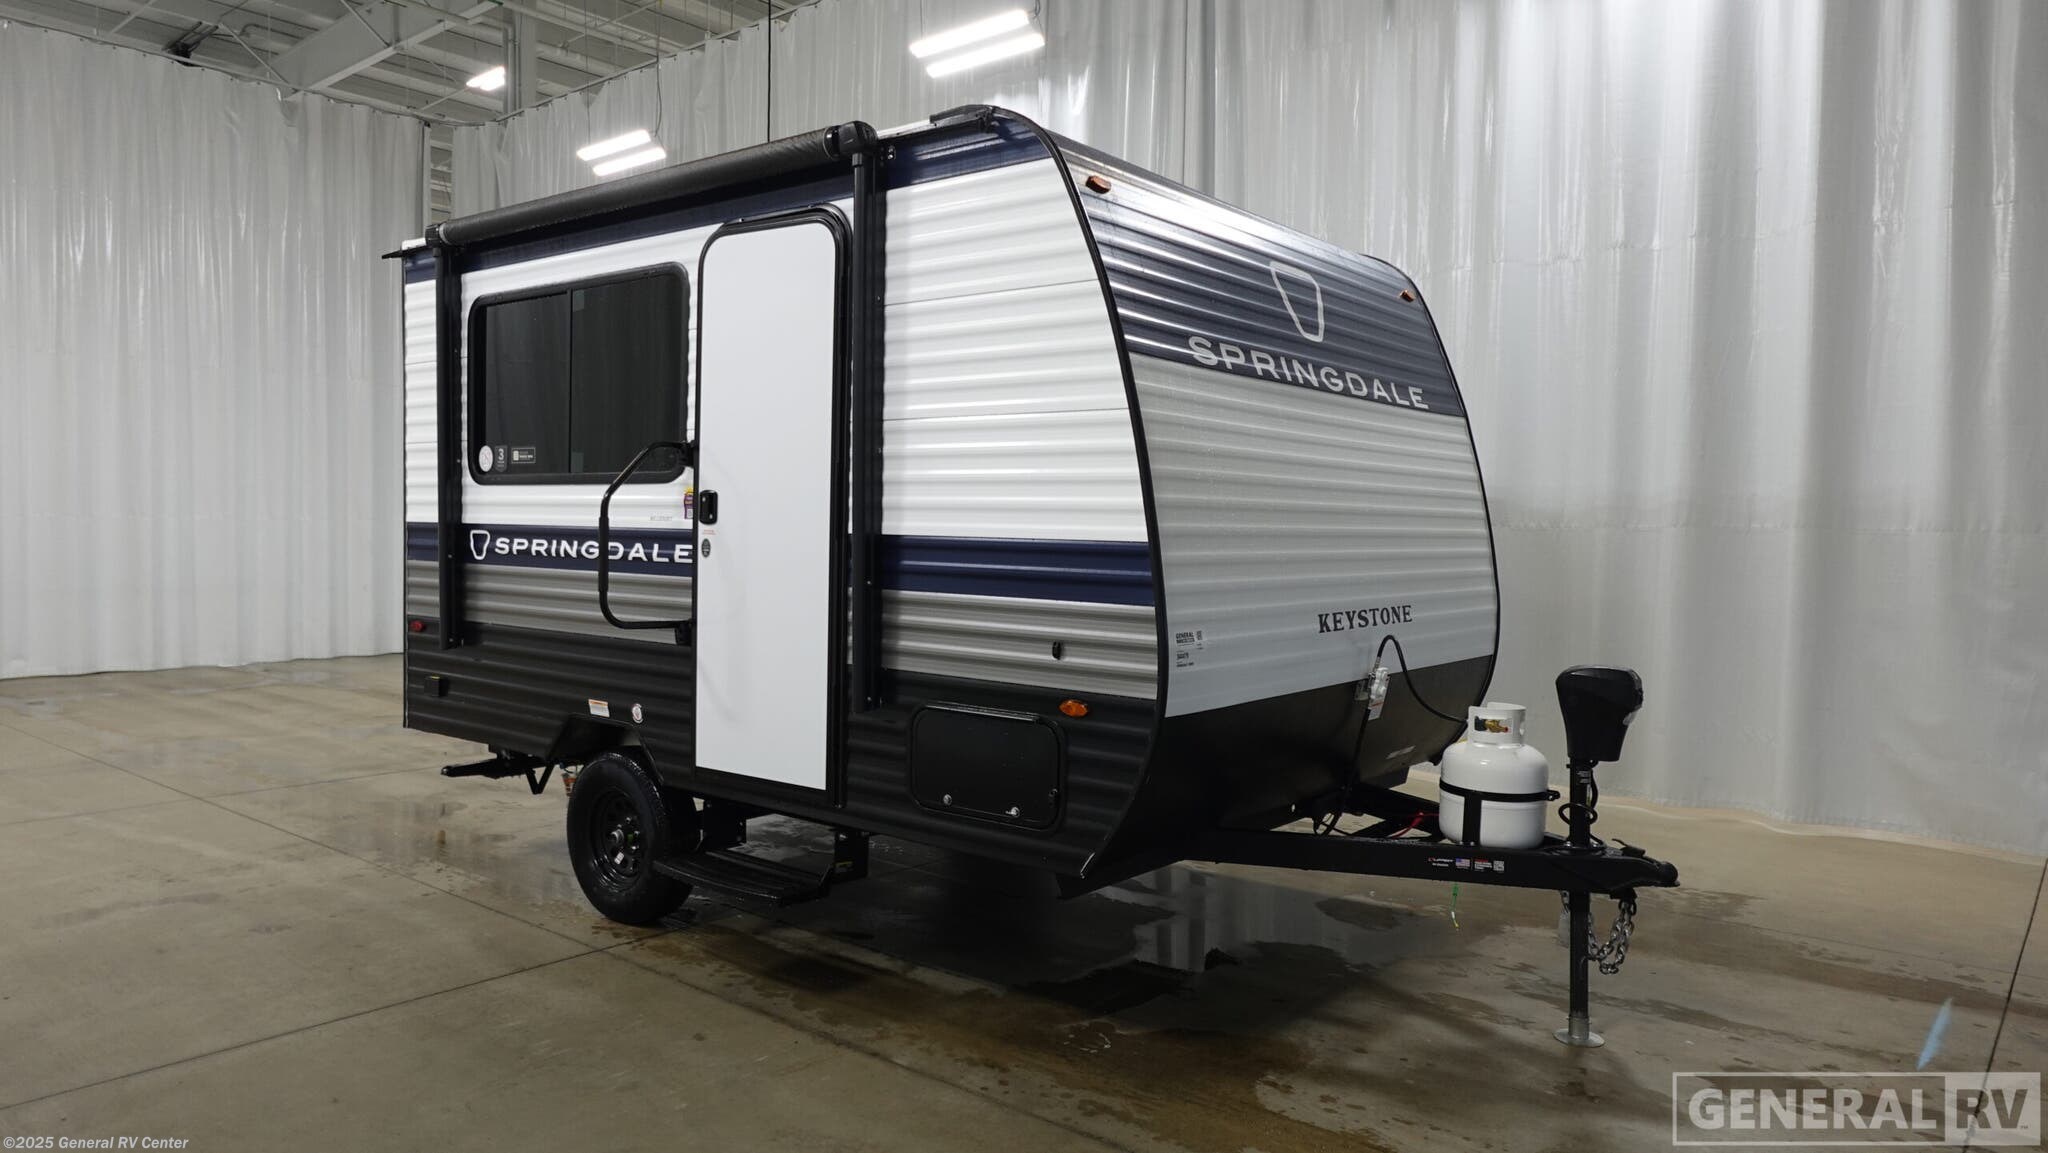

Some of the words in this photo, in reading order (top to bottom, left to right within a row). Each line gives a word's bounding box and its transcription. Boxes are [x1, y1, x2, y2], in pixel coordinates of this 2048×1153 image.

[1188, 336, 1429, 409] SPRINGDALE
[498, 448, 505, 460] 3
[494, 537, 694, 564] SPRINGDALE
[1318, 605, 1413, 633] KEYSTONE
